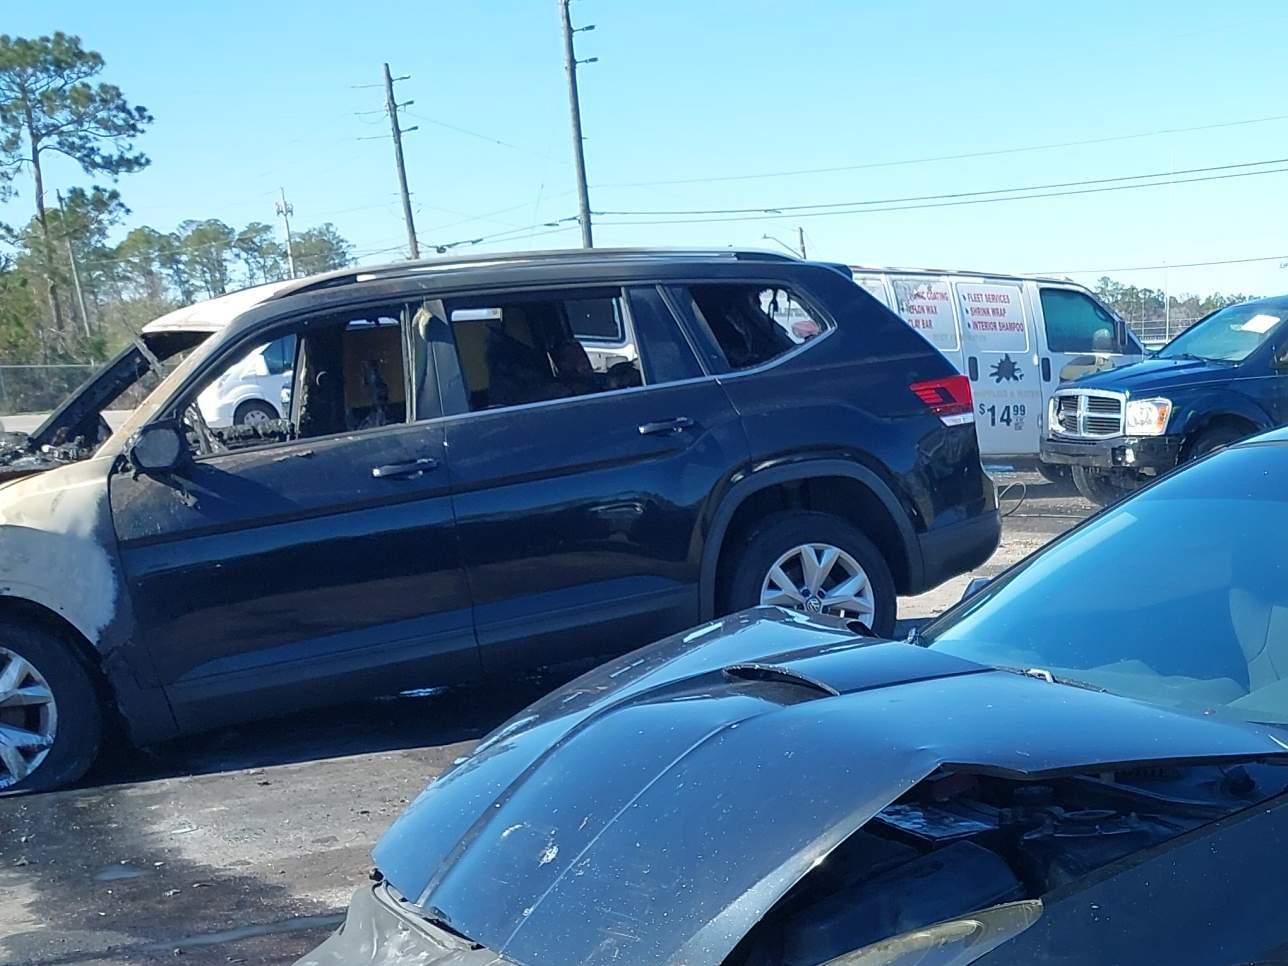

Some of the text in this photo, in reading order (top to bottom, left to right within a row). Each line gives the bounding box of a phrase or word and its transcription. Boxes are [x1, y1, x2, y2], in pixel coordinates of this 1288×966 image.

[967, 293, 1010, 304] FLEET SERVICES
[970, 306, 1007, 317] SHRINK WRAP
[972, 320, 1024, 332] INTERIOR SHAMPOO
